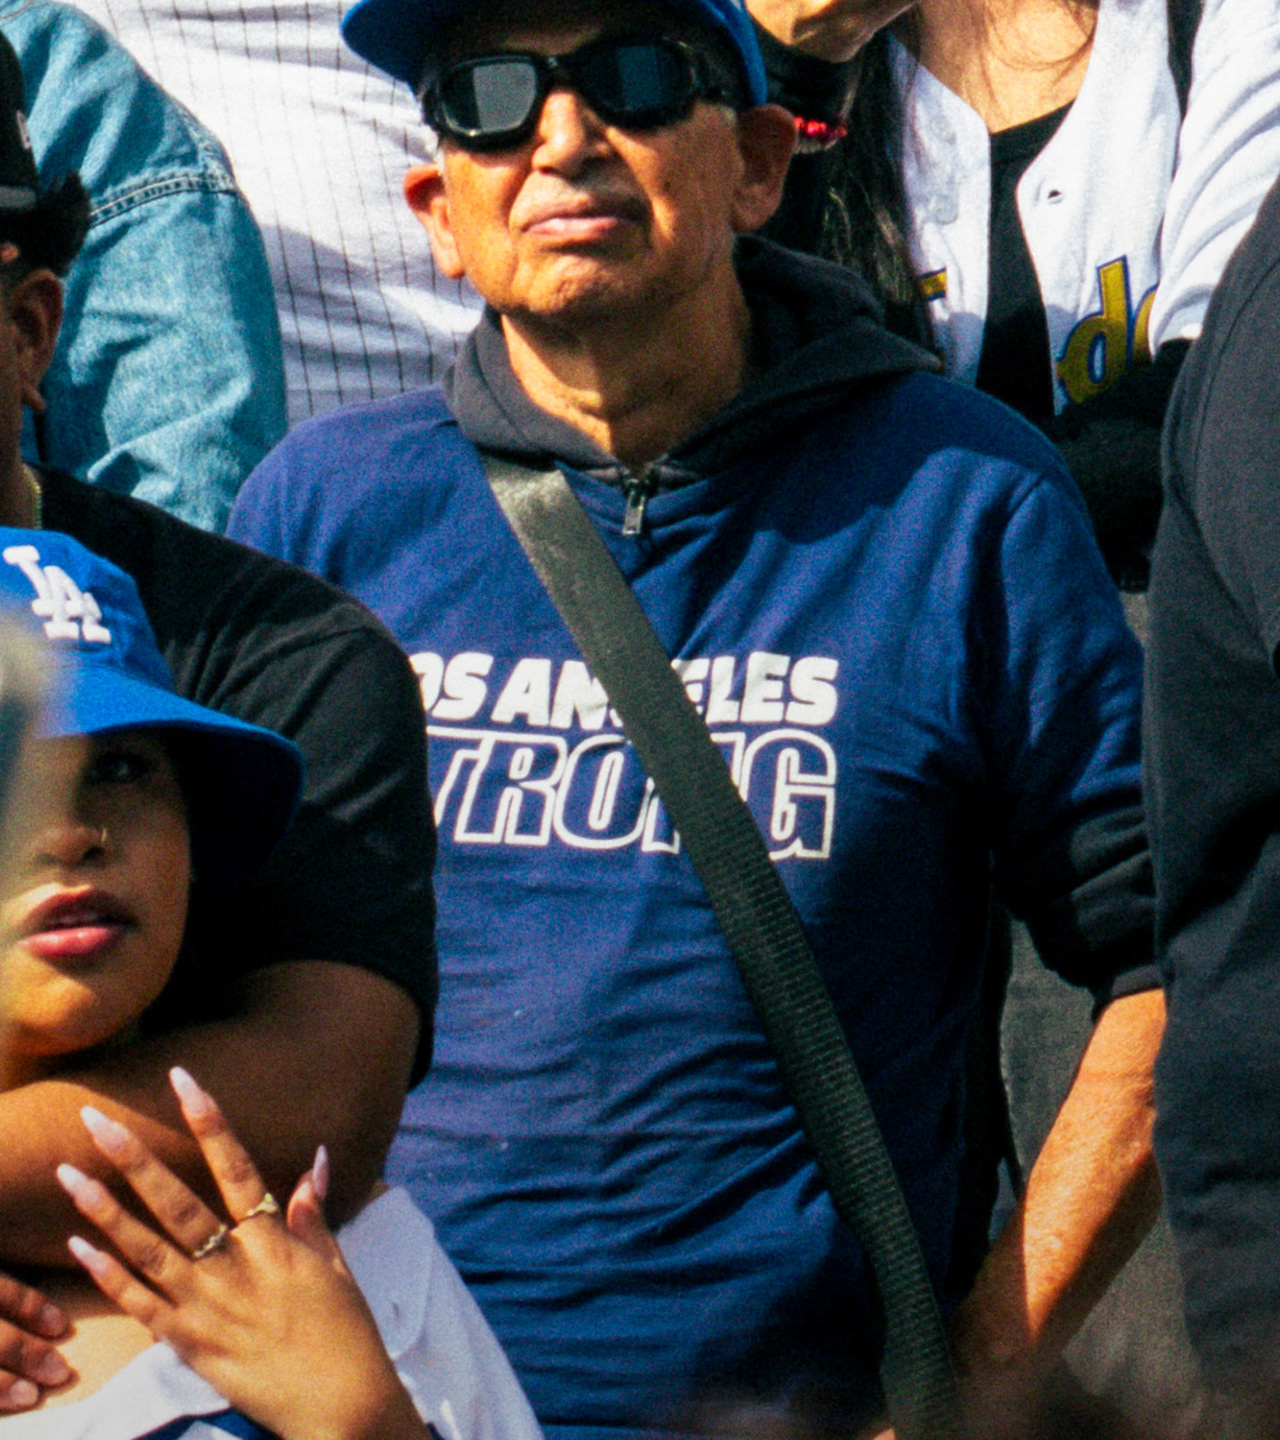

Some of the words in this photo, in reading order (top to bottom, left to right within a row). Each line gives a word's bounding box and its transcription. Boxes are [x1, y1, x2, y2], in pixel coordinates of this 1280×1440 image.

[2, 545, 111, 645] LA
[409, 651, 494, 721] OS
[490, 651, 840, 731] ANELES
